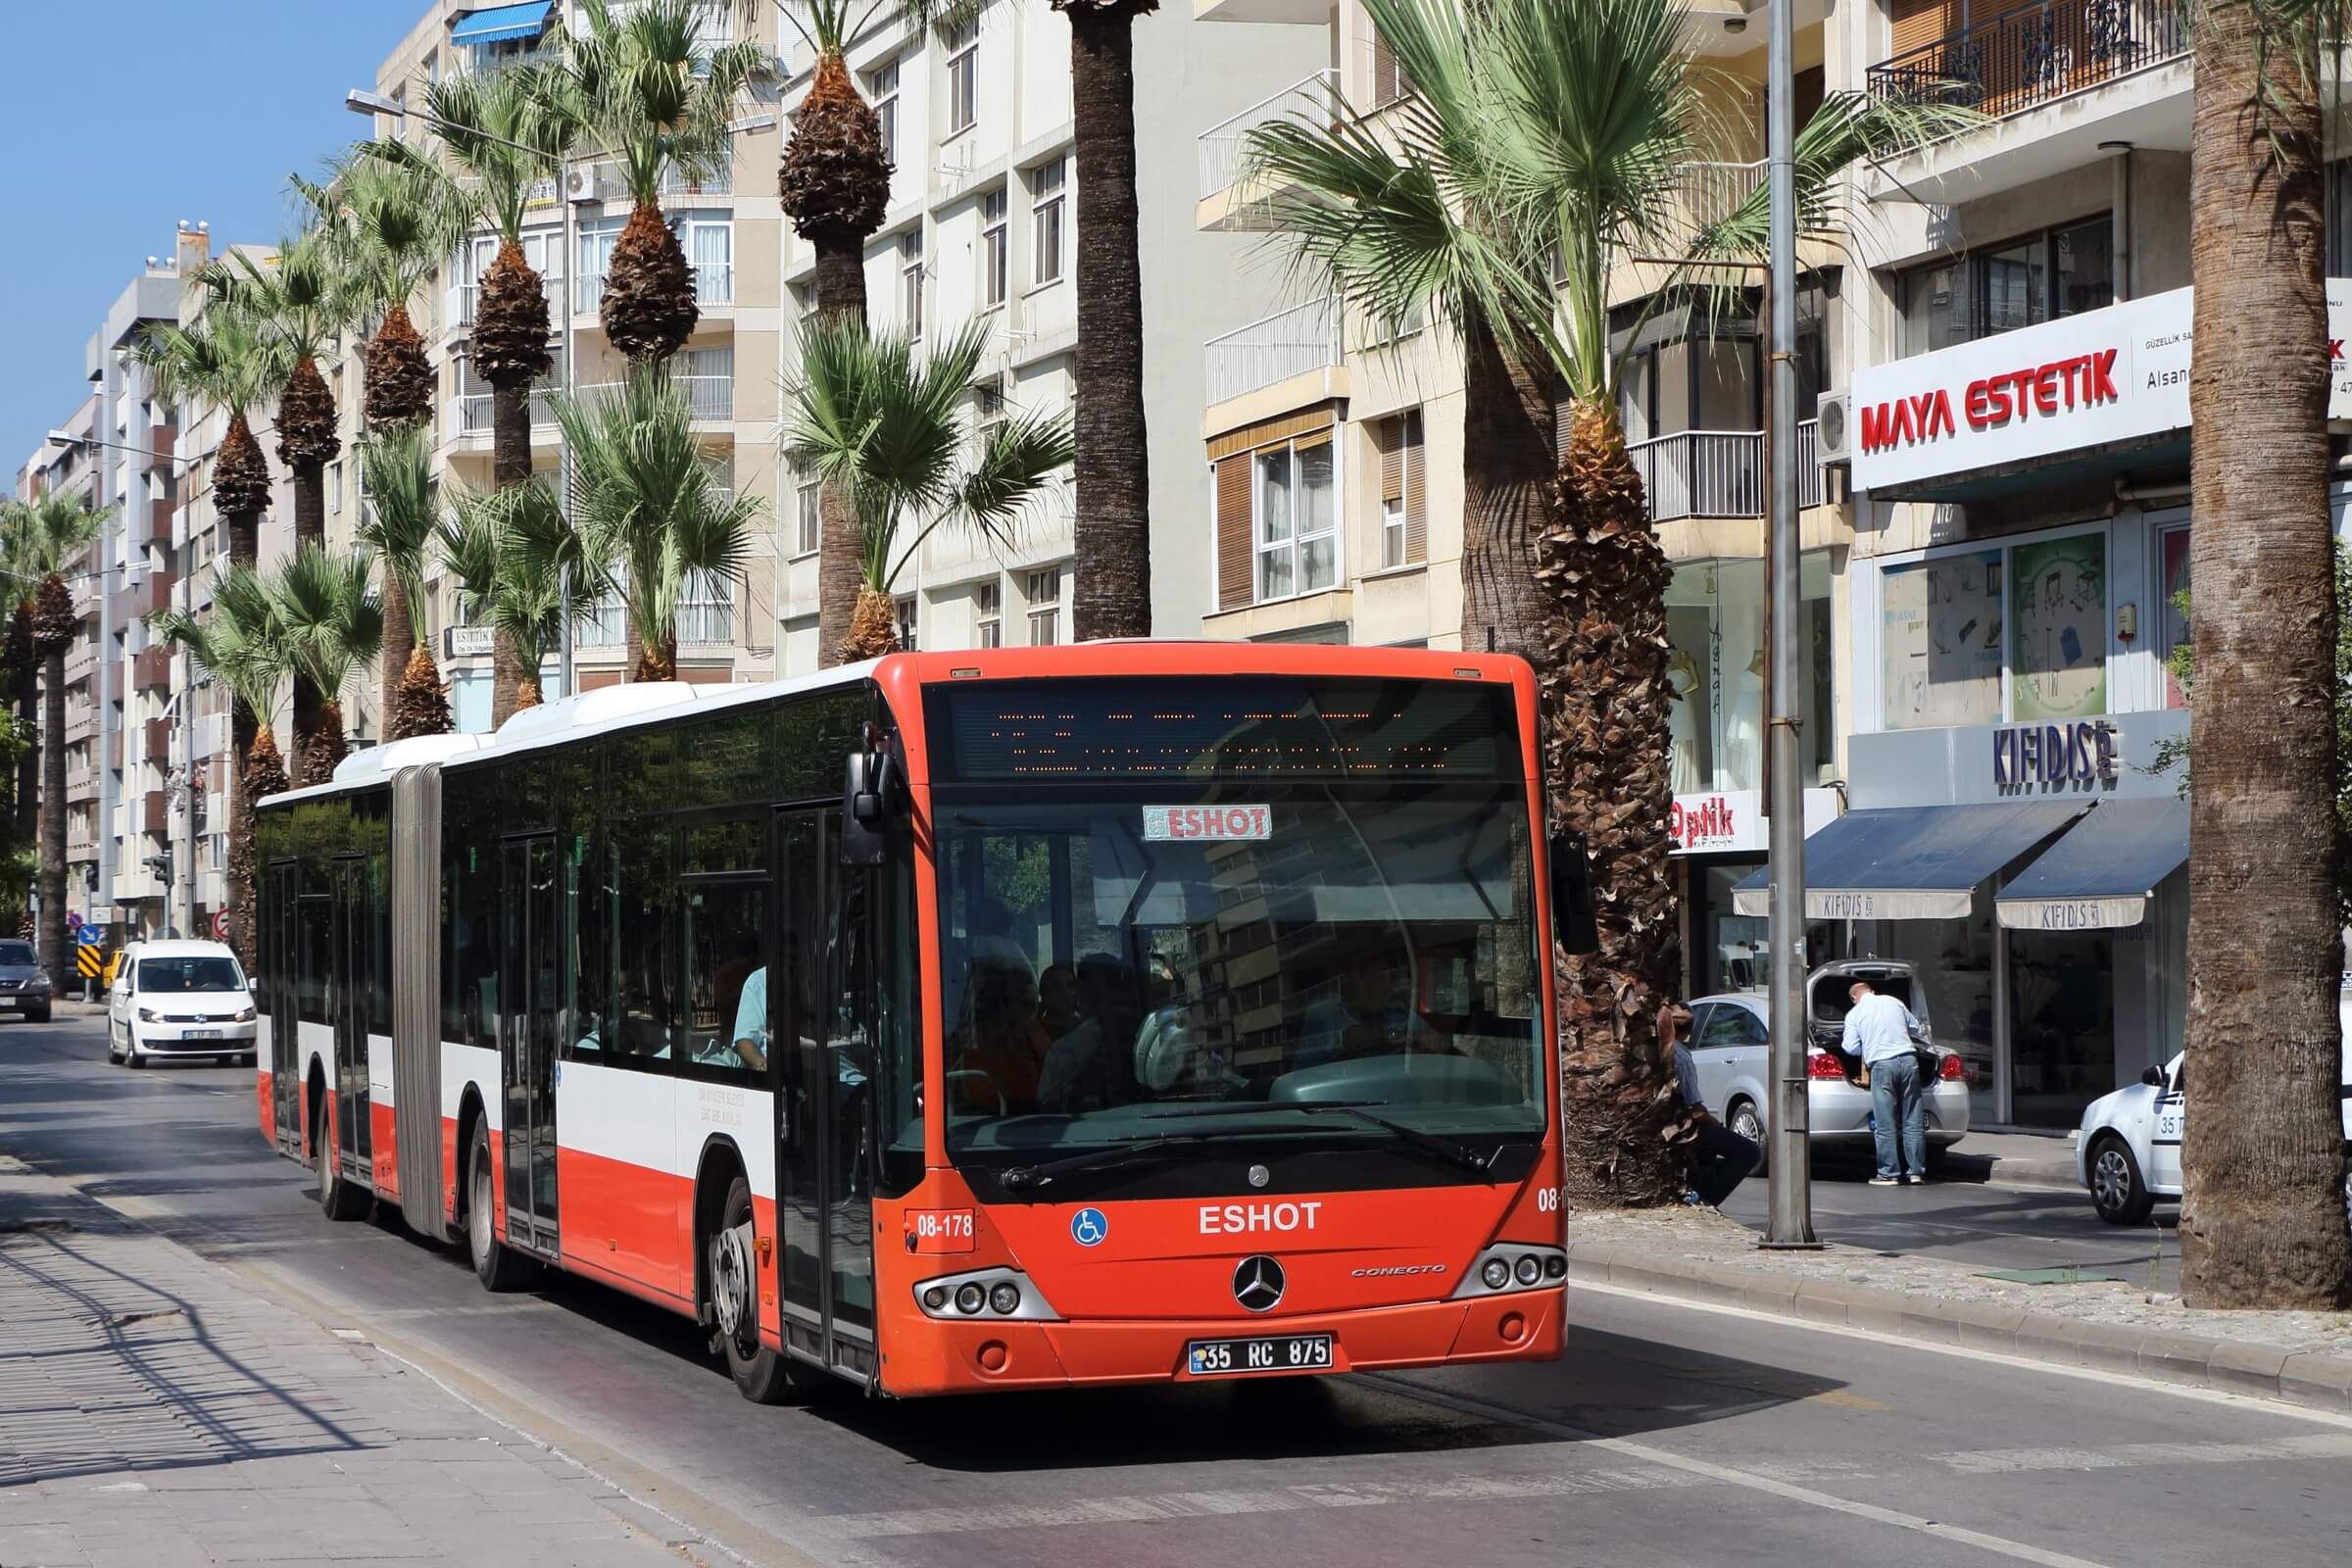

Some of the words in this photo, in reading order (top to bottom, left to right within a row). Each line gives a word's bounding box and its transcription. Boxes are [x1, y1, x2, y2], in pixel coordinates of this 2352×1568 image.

[1861, 389, 1955, 452] MAYA
[1993, 722, 2092, 784] KIFIDIS
[1167, 808, 1265, 837] ESHOT
[1669, 797, 1735, 849] Optik
[1824, 894, 1861, 917] KIFIDIS
[2042, 904, 2085, 927] KIFIDIS
[2161, 1116, 2175, 1134] 35
[918, 1214, 972, 1238] 08-178
[1200, 1201, 1322, 1234] ESHOT
[1351, 1264, 1447, 1278] CONECTO
[1204, 1344, 1231, 1369] 35
[1249, 1342, 1273, 1367] RC
[1289, 1339, 1327, 1365] 875
